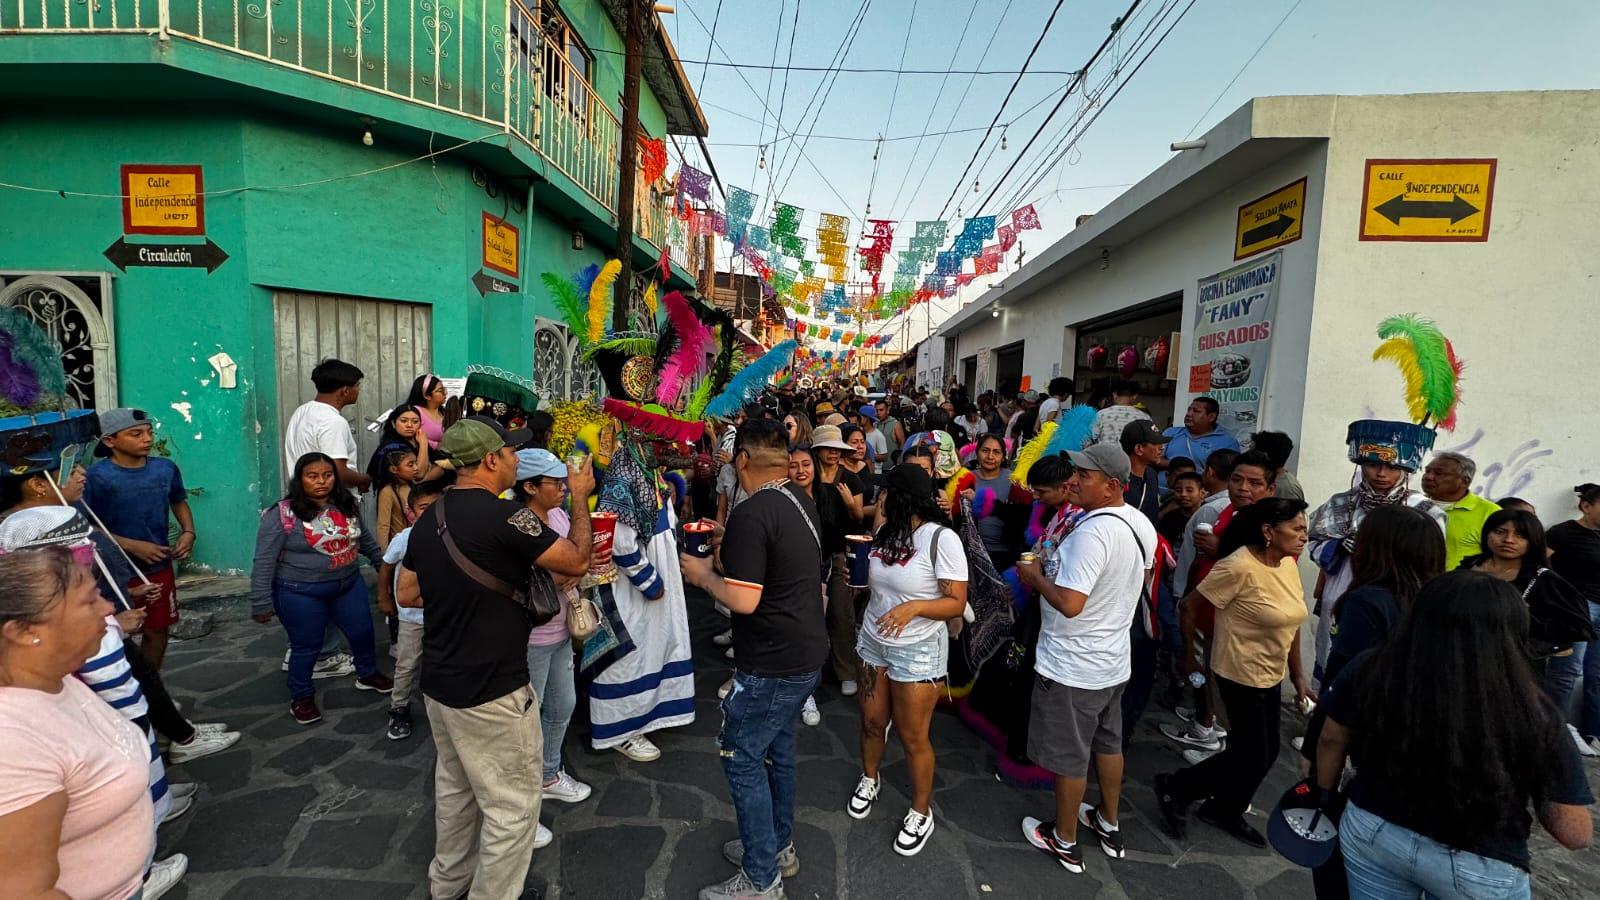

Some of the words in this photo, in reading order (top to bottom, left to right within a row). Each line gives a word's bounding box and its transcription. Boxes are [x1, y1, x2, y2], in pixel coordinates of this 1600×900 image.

[148, 177, 171, 188] Calle
[1379, 172, 1404, 181] CALLE
[1404, 182, 1480, 197] INDEPENDENCIA
[135, 194, 196, 211] Independencia
[139, 248, 192, 264] Circulación
[1198, 322, 1269, 350] GUISADOS
